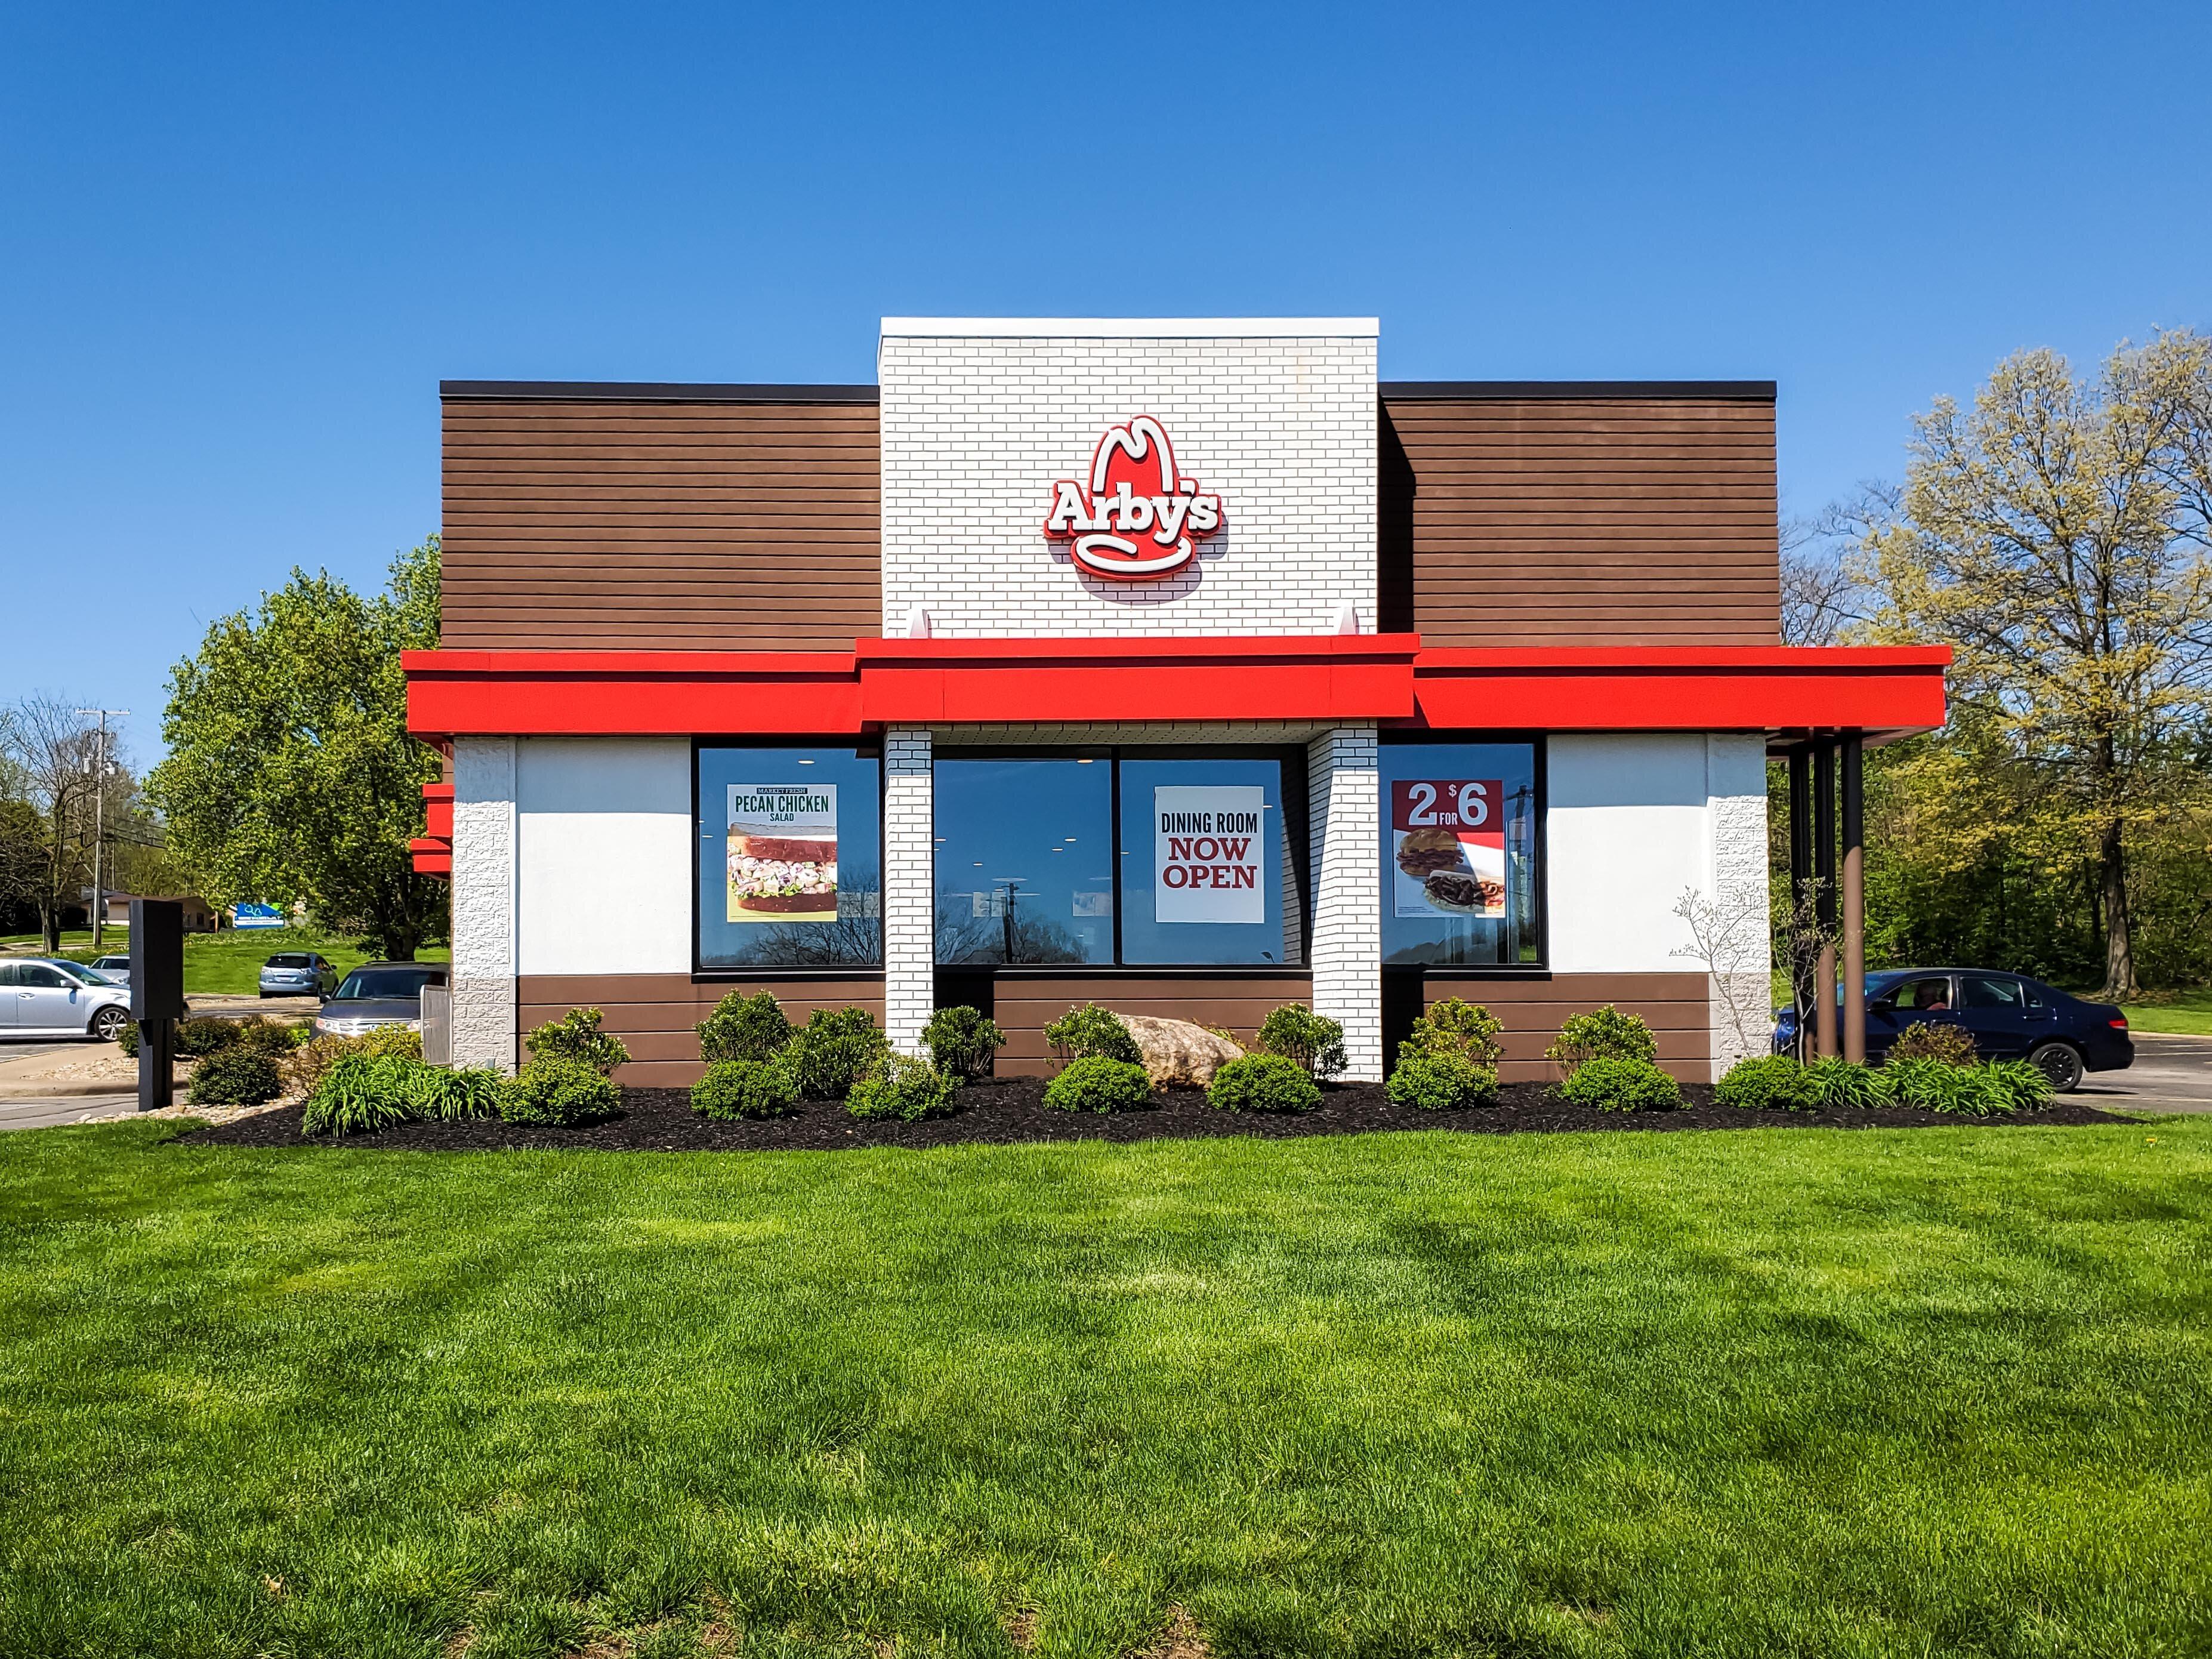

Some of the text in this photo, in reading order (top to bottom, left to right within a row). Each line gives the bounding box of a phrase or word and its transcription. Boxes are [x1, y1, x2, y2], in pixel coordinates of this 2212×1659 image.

[1048, 480, 1218, 544] Arby's
[736, 795, 829, 812] PECAN CHICKEN
[1408, 783, 1437, 826] 2
[1439, 812, 1458, 825] FOR
[770, 813, 794, 822] SALAD
[1161, 813, 1257, 833] DINING ROOM
[1168, 837, 1251, 861] NOW
[1162, 865, 1257, 889] OPEN
